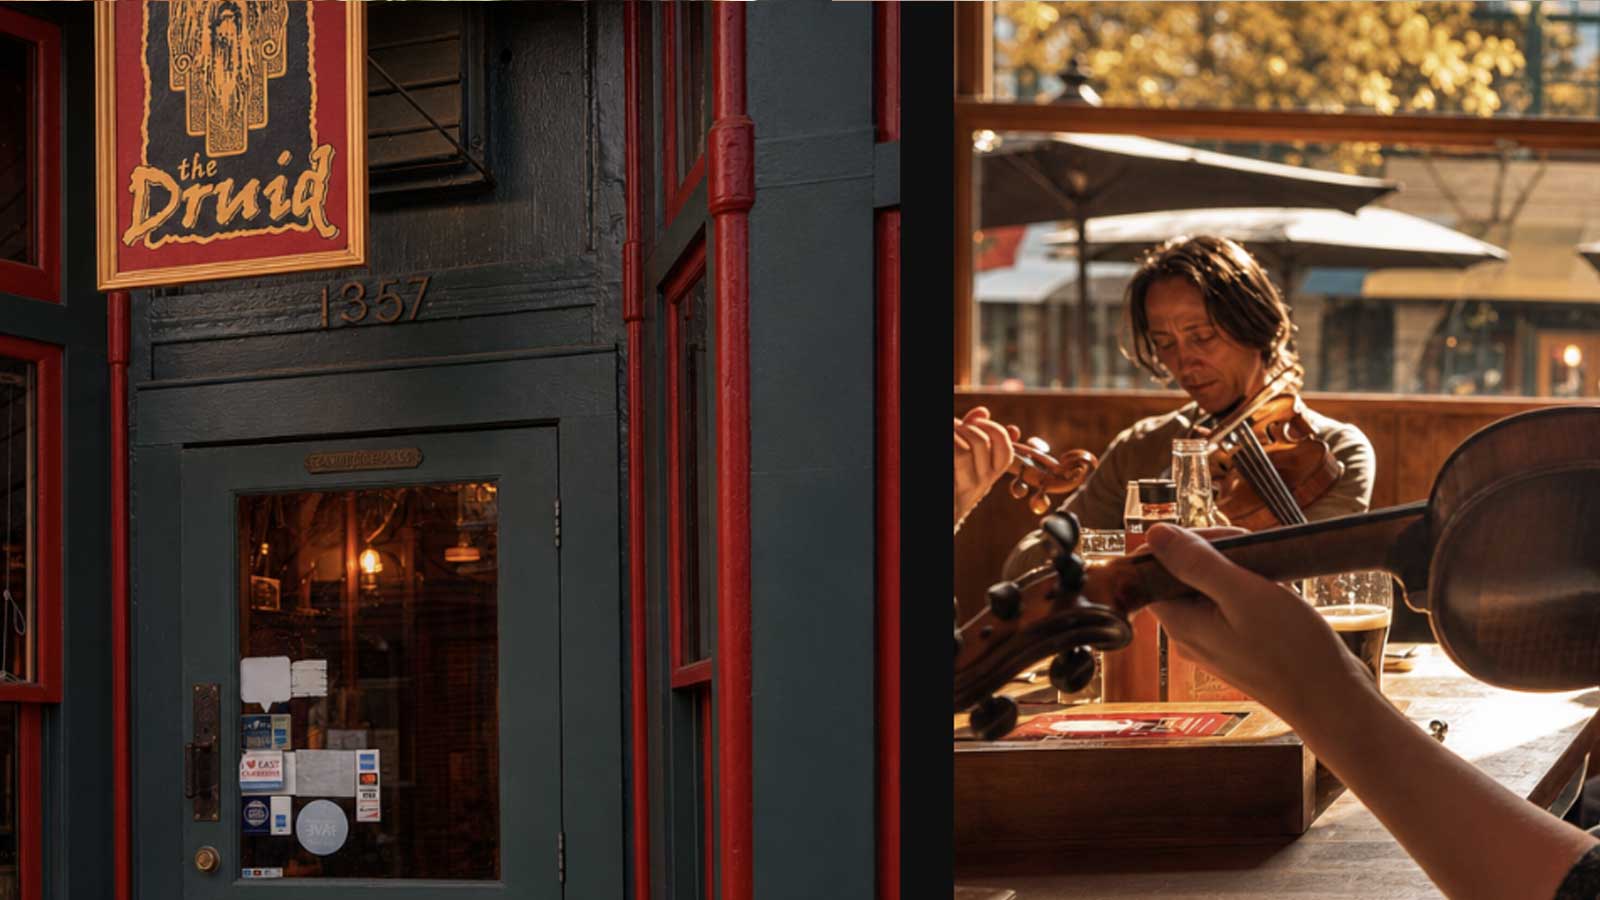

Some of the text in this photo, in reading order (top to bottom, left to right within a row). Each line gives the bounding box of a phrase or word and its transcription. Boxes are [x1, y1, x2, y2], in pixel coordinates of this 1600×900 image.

[178, 152, 218, 180] the
[122, 144, 339, 247] Druid
[321, 276, 432, 329] 1357
